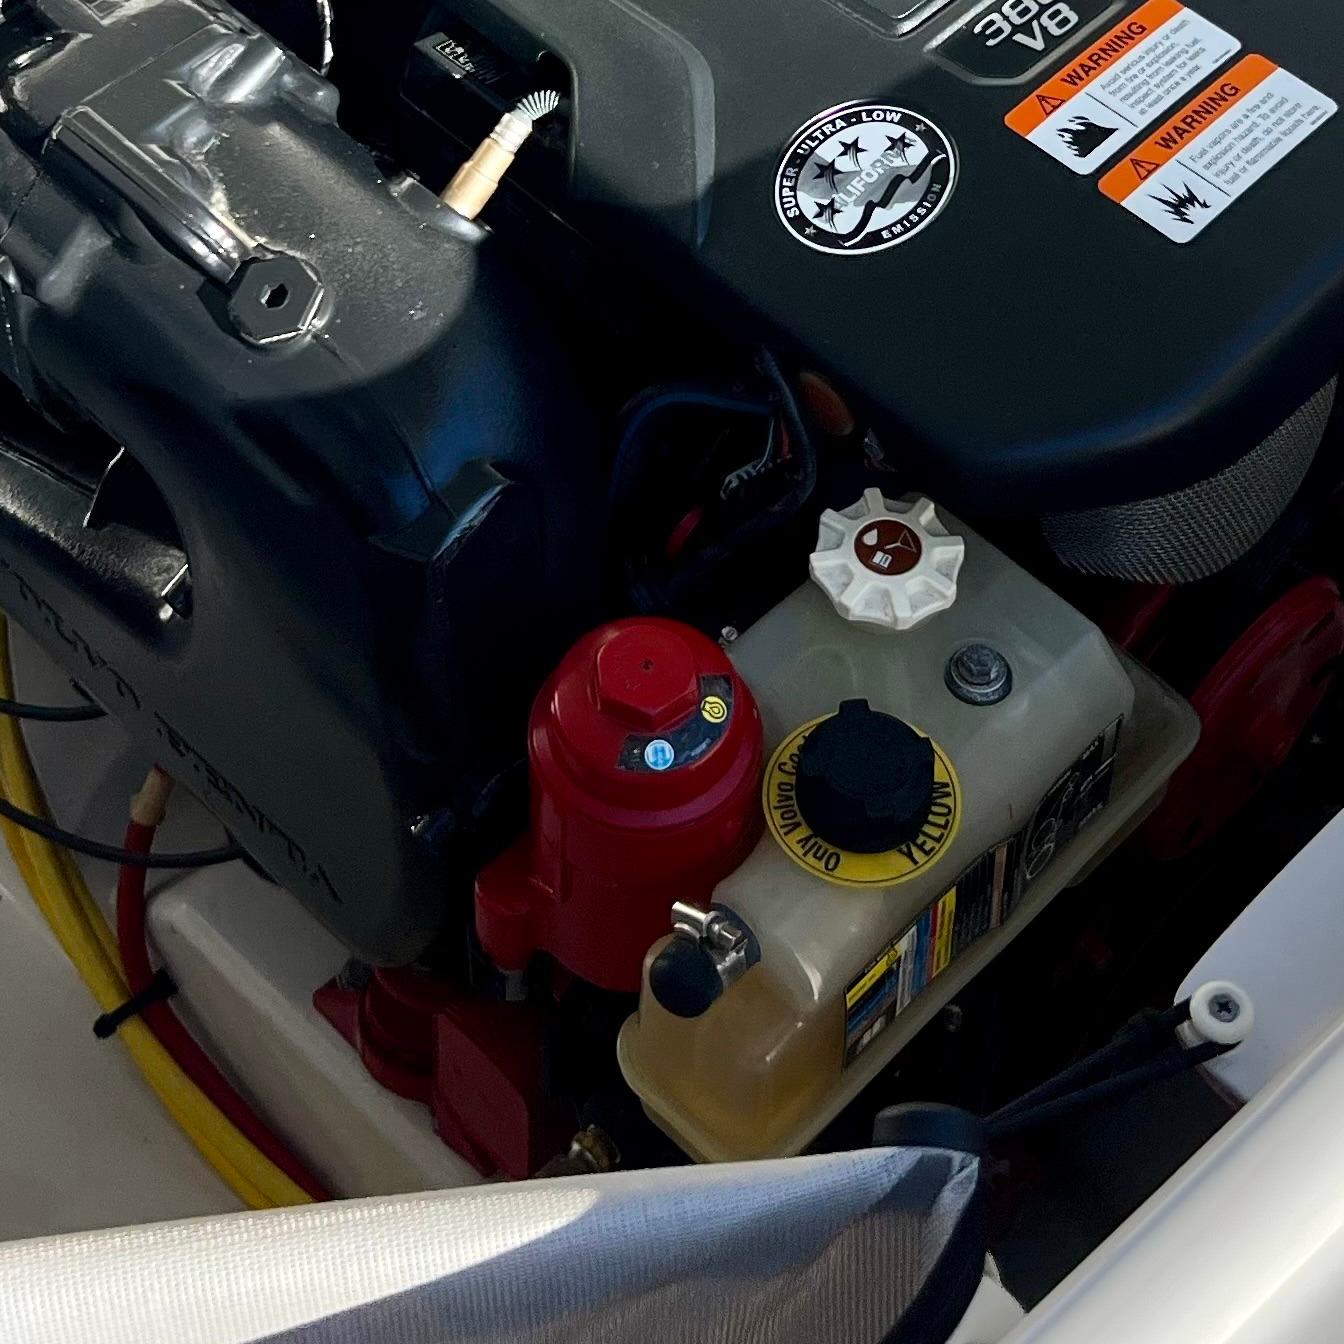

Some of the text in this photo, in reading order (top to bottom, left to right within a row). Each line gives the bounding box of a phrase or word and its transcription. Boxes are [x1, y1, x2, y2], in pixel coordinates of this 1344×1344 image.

[1012, 2, 1079, 51] V8
[1060, 21, 1147, 88] WARNING
[1154, 83, 1240, 150] WARNING
[881, 183, 942, 239] EMISSION
[774, 781, 802, 836] Volvo
[897, 780, 953, 866] YELLOW
[797, 833, 840, 872] Only
